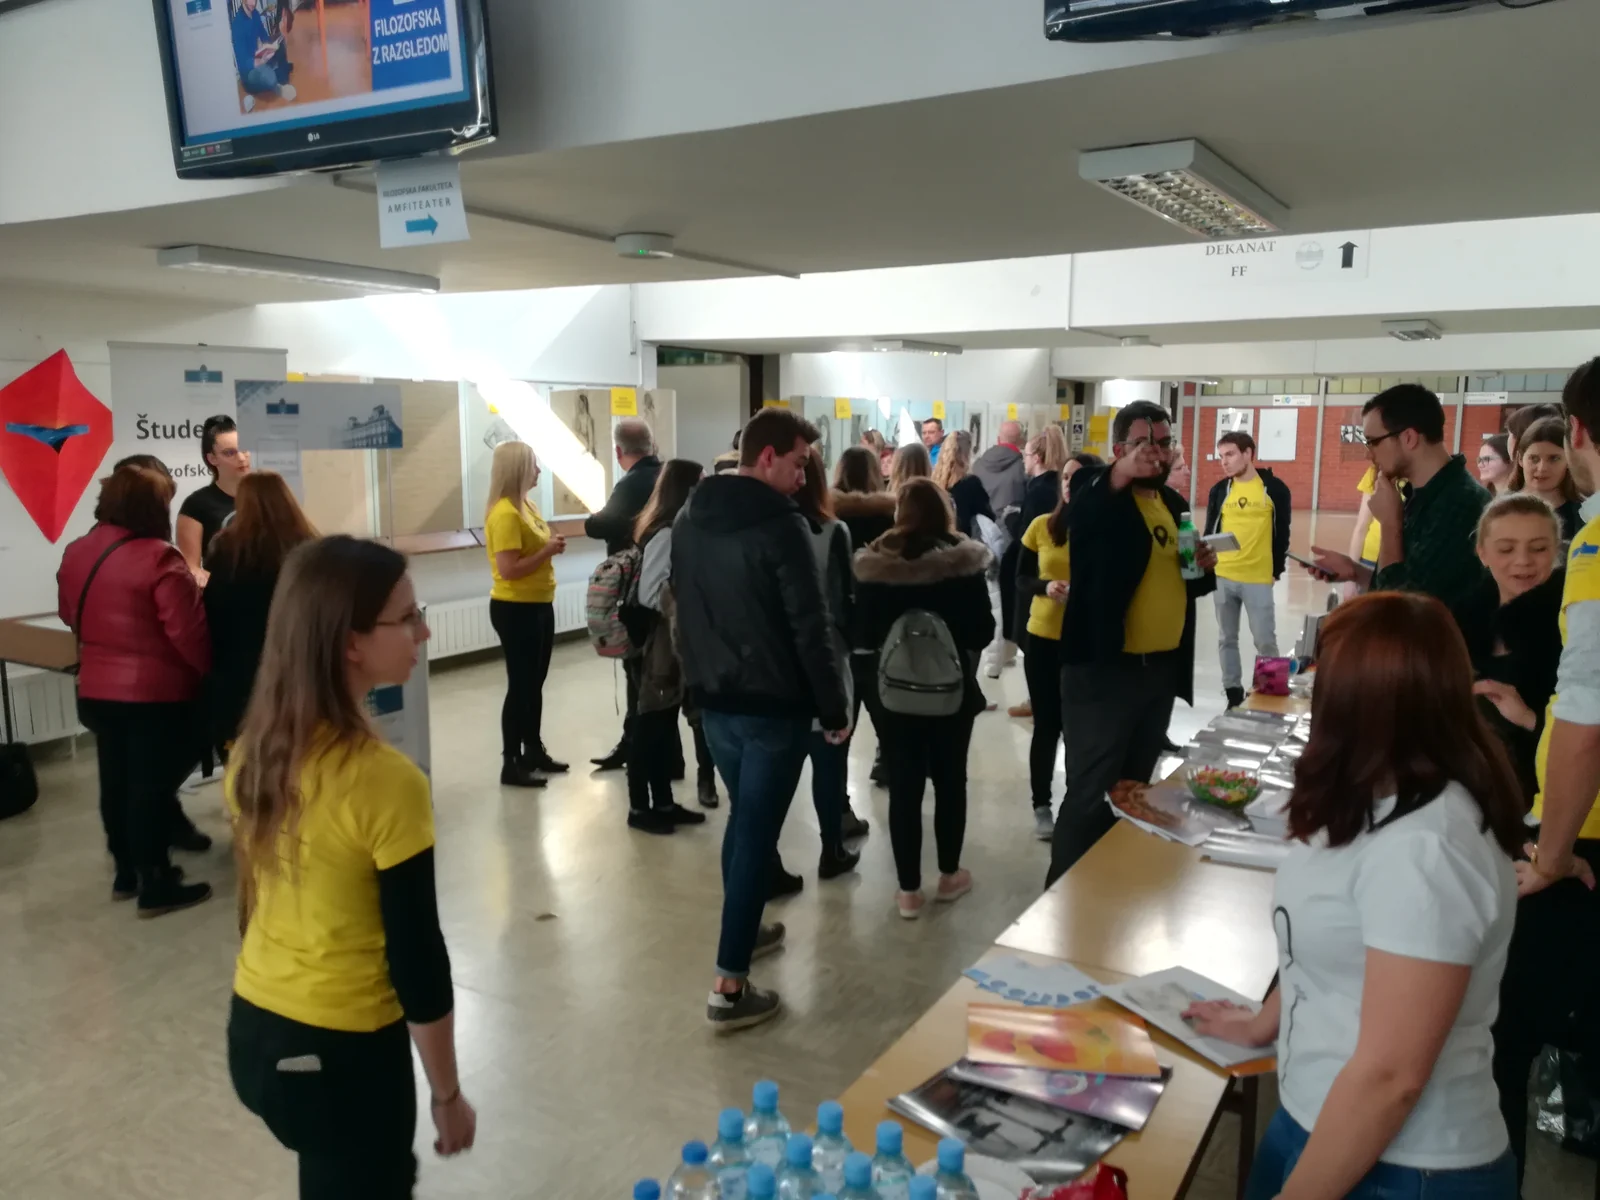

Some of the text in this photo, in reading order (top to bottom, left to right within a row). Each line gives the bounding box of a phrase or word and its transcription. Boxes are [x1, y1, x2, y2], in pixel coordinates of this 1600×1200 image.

[374, 7, 441, 38] FILOZOFSKA
[372, 33, 449, 65] Z RAZGLEDOM
[382, 181, 453, 198] FILOZOFSKA FAKULTETA
[387, 197, 452, 214] AMFITEATER
[1205, 240, 1276, 256] DEKANAT
[1231, 265, 1248, 277] FF
[136, 413, 205, 440] Štude
[167, 463, 214, 478] zofsk
